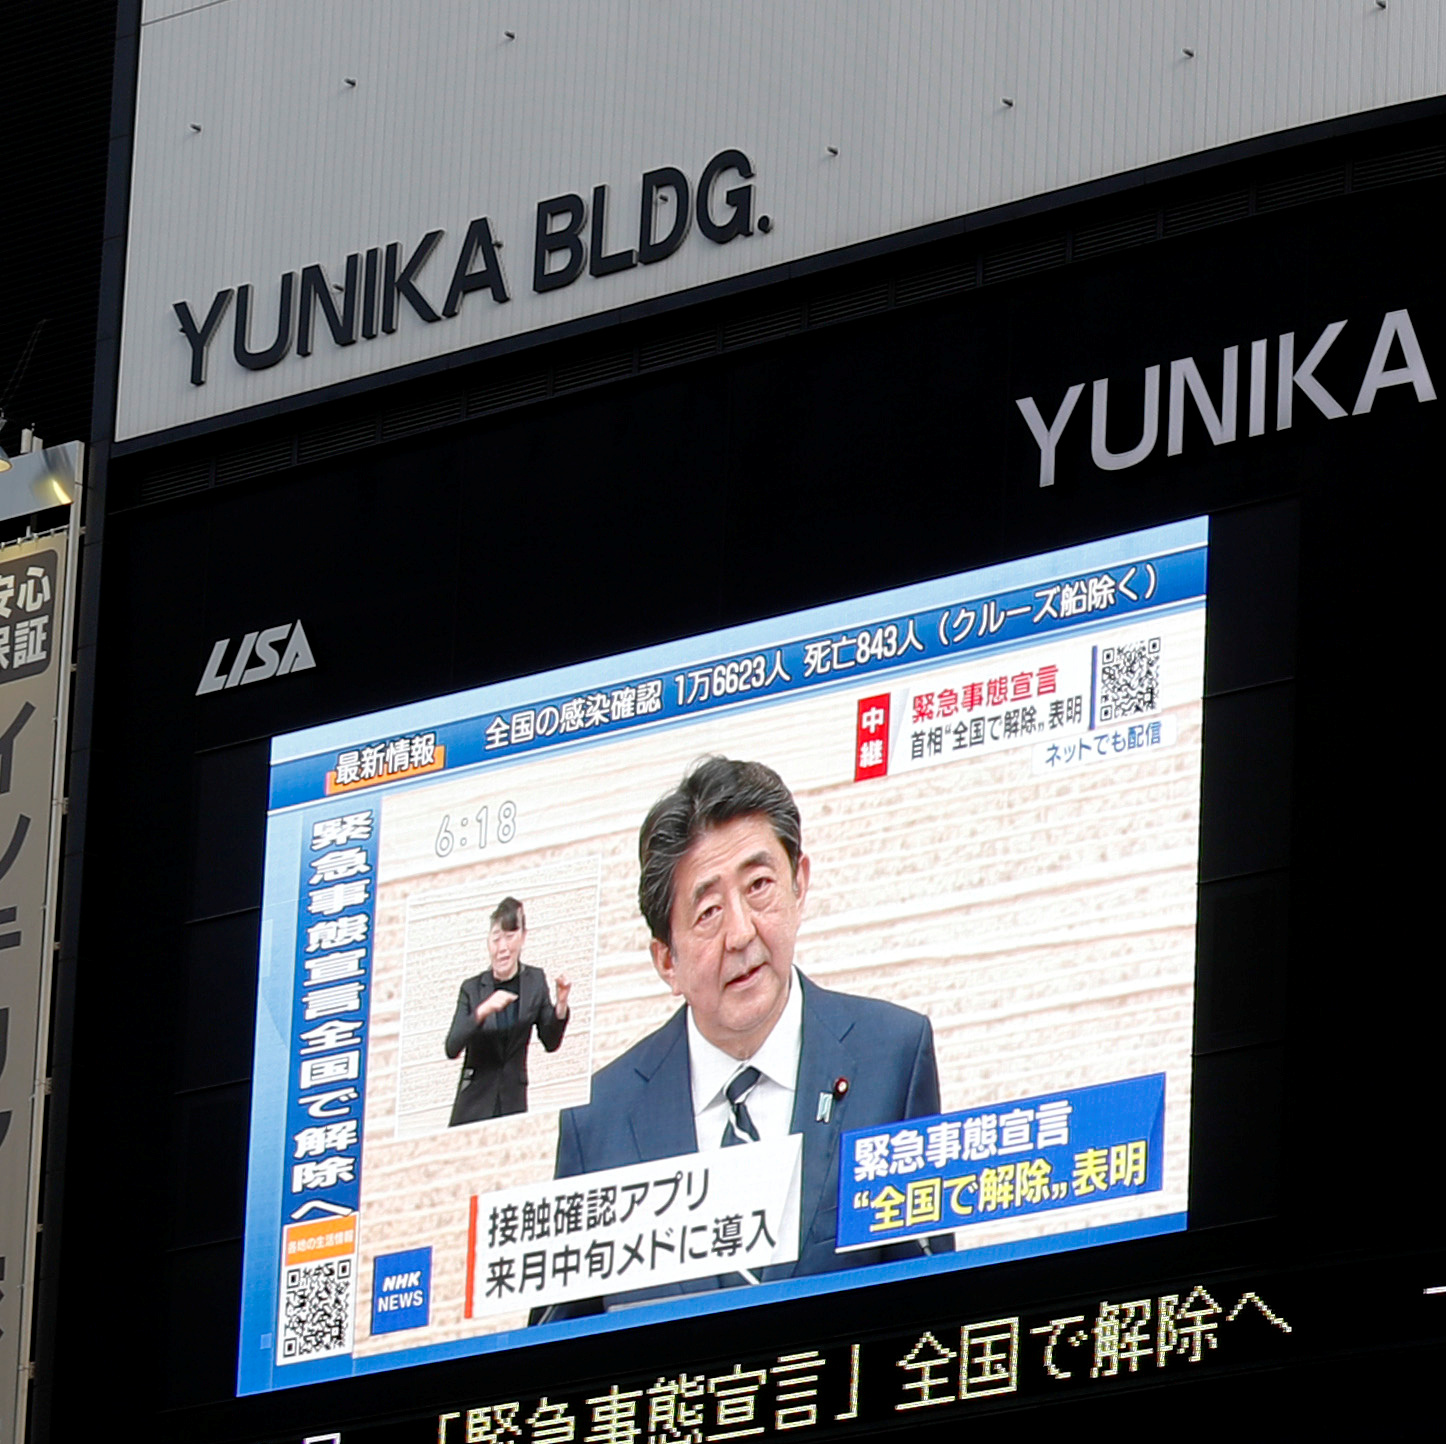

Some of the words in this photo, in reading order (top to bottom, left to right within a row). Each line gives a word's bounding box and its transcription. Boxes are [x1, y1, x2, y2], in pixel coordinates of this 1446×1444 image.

[173, 218, 511, 387] YUNIKA
[533, 149, 774, 295] BLDG.
[1015, 308, 1437, 487] YUNIKA
[195, 619, 316, 696] LISA
[912, 664, 1059, 723] 緊急事態宣言
[485, 682, 662, 750] 全国の感染確認
[675, 649, 791, 707] 1万6623人
[336, 734, 436, 785] 最新情報
[860, 708, 885, 769] 中継
[1045, 721, 1162, 768] ネットでも配信
[435, 800, 517, 857] 6:18
[290, 810, 373, 1221] 緊急事態宣言全国で解除へ
[854, 1100, 1073, 1181] 緊急事態宣言
[488, 1168, 710, 1249] 接触確認アプリ
[382, 1271, 421, 1291] NHK
[486, 1208, 776, 1299] 来月中旬メドに導入
[377, 1290, 423, 1312] NEWS
